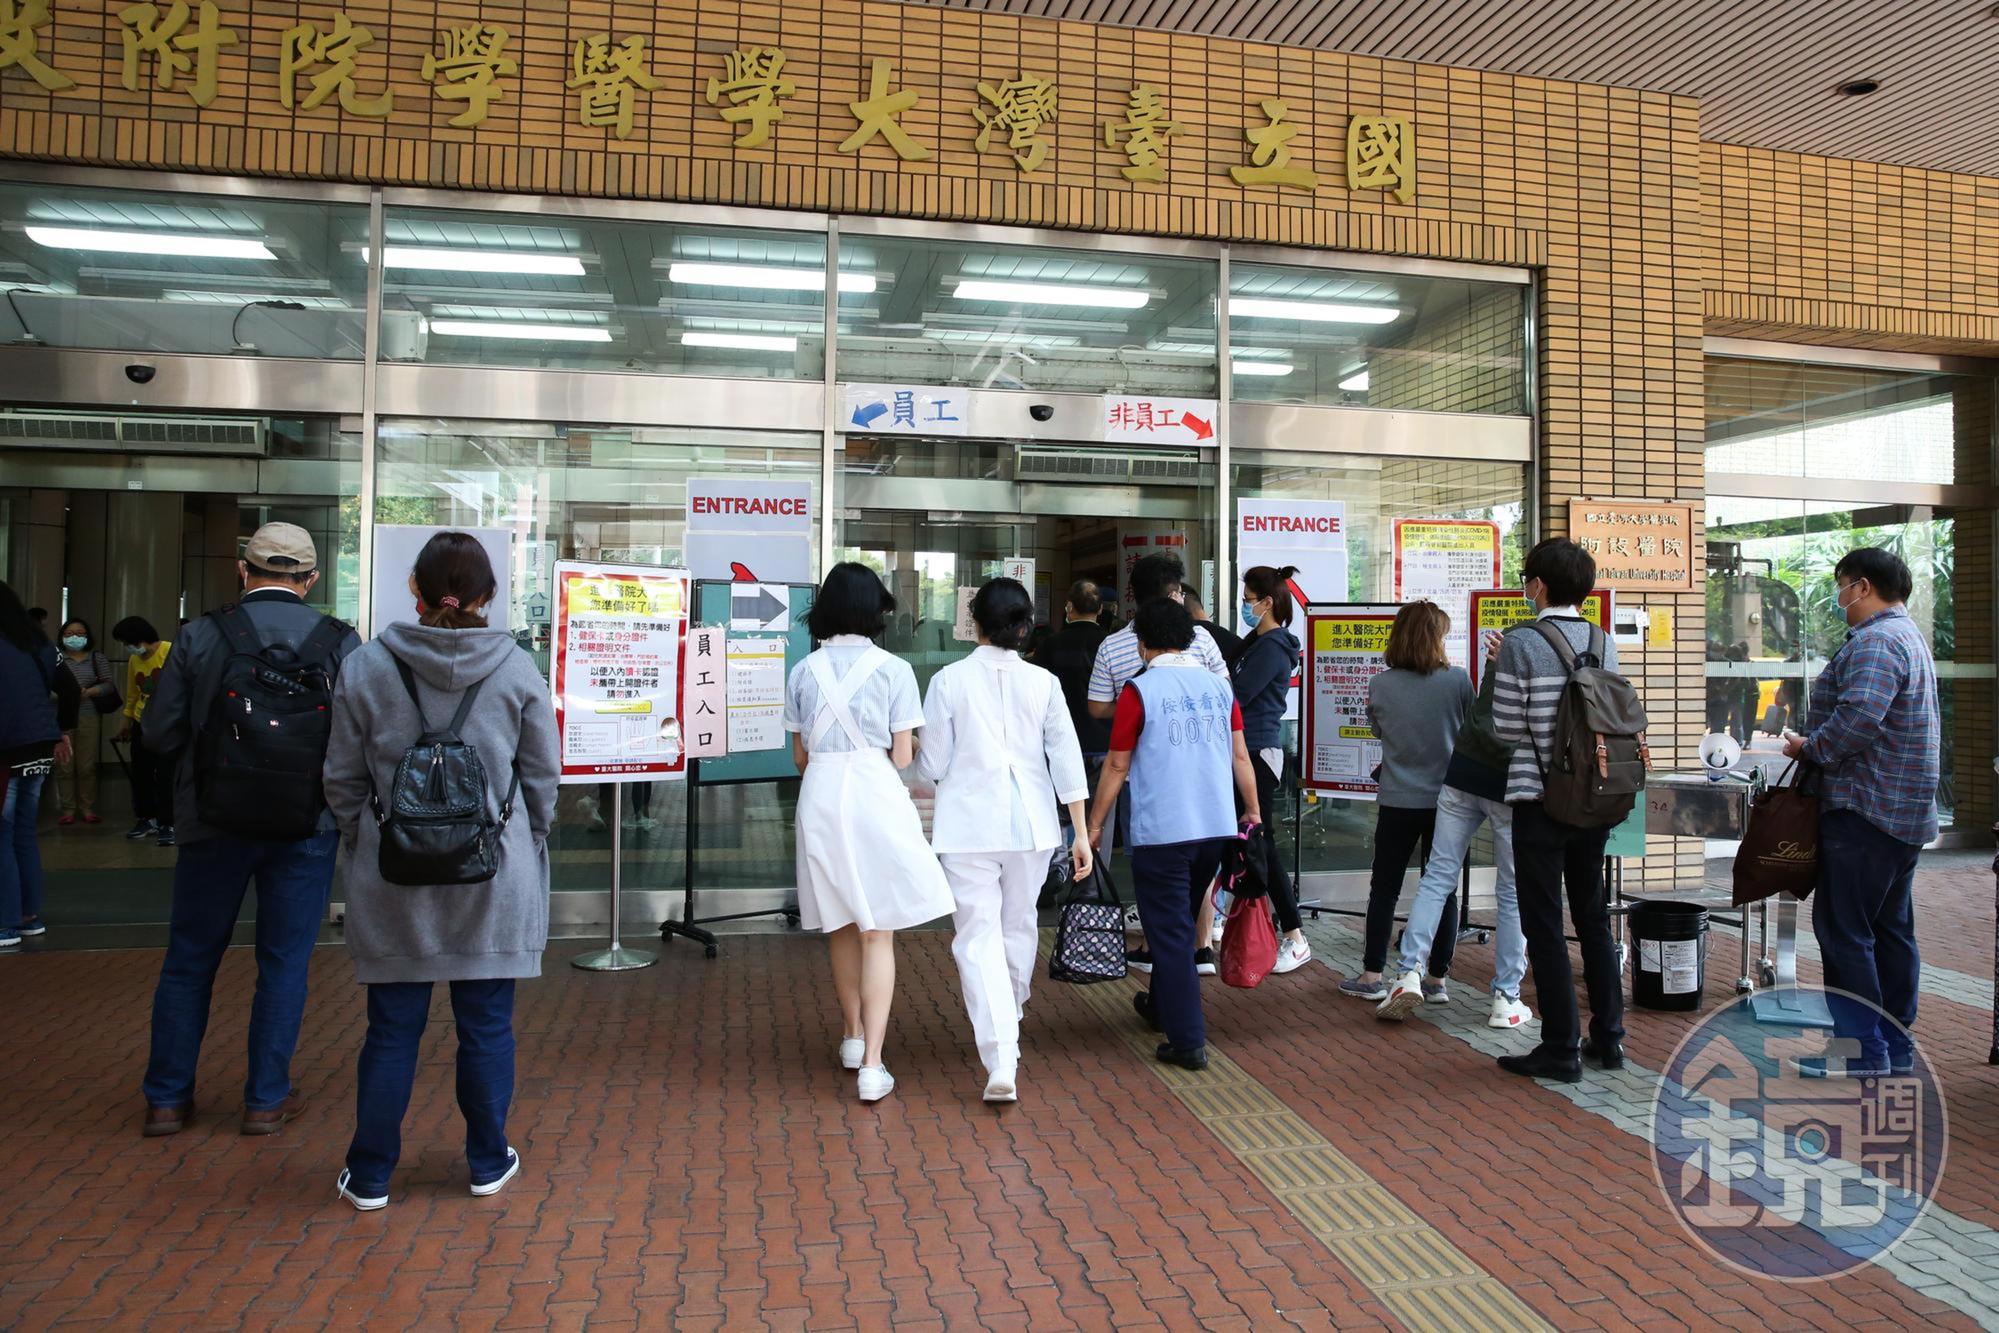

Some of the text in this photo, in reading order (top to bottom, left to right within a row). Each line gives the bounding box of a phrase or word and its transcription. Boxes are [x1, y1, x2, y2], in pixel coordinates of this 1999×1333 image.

[890, 390, 959, 429] 員工
[1108, 402, 1181, 433] 非員工
[692, 496, 807, 516] ENTRANCE
[1242, 515, 1341, 533] ENTRANCE
[1580, 535, 1685, 558] 附設醫院
[606, 689, 641, 699] 請勿進入
[695, 633, 716, 747] 員工入口
[1334, 706, 1368, 716] 未攜帶上
[1770, 840, 1817, 859] Lind
